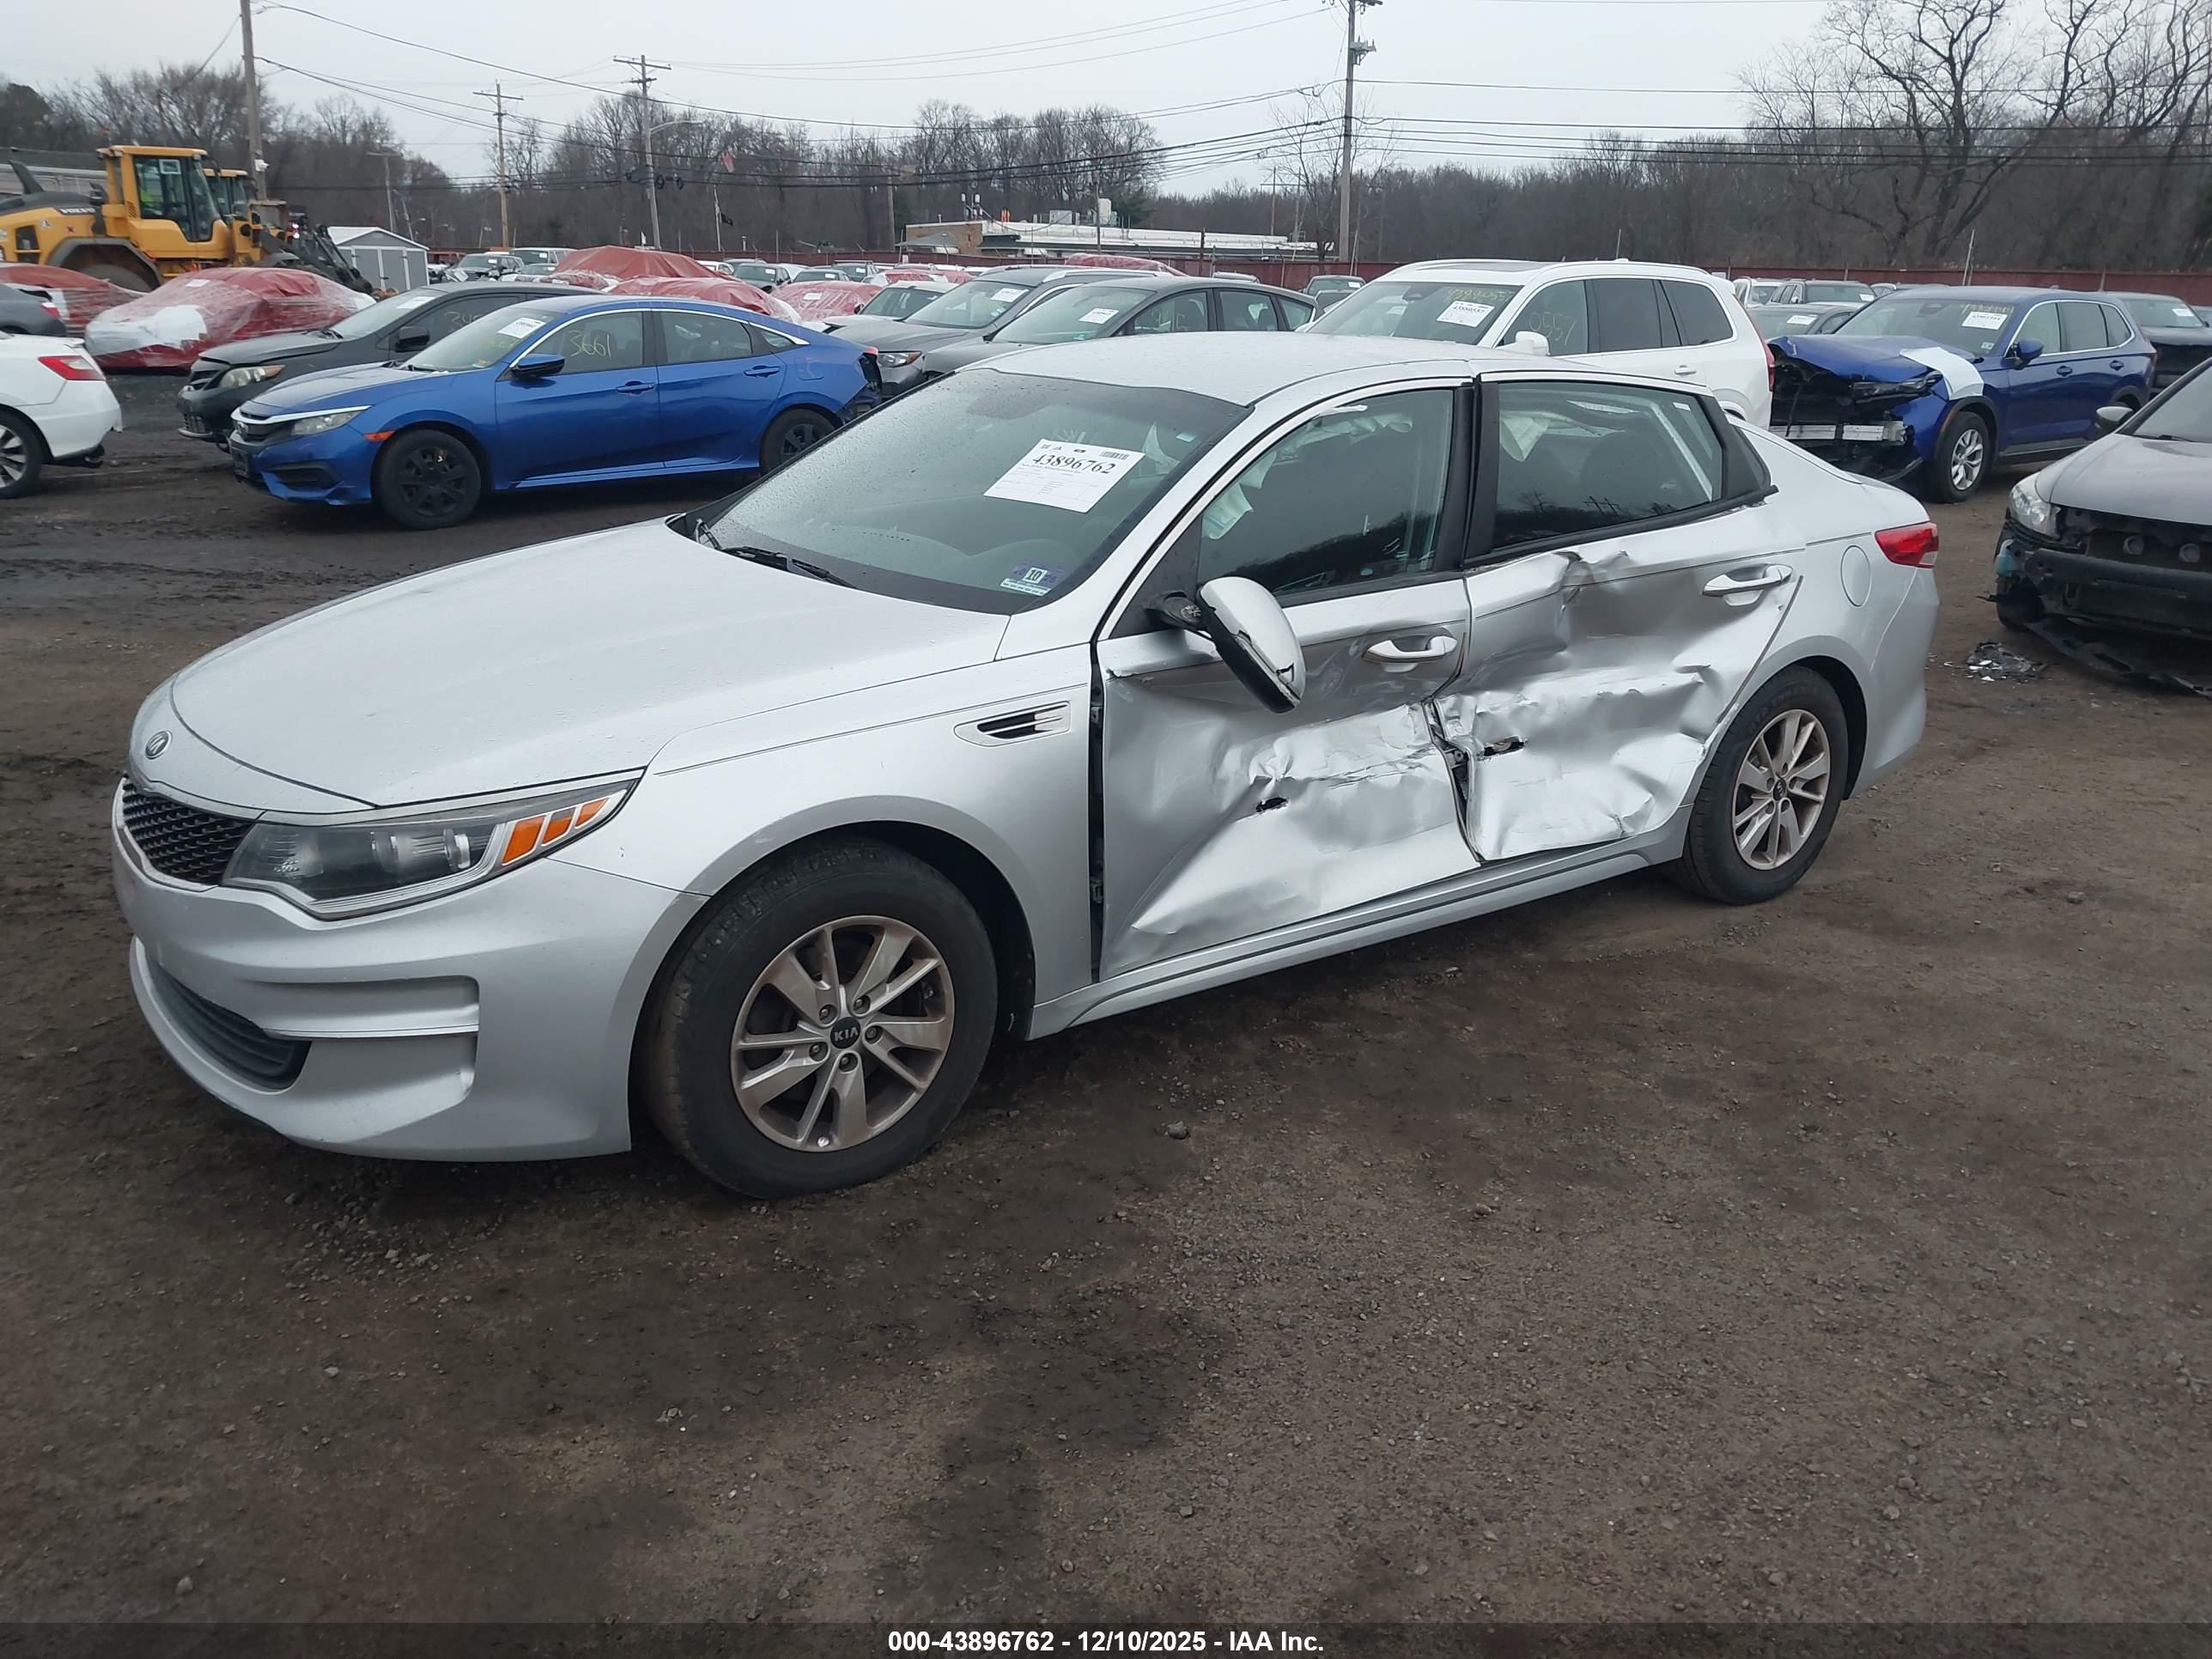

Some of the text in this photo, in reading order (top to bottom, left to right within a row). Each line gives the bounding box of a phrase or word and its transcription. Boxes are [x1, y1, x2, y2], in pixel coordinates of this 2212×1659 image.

[568, 330, 611, 359] 3661
[1032, 453, 1116, 474] 43896762
[1025, 569, 1042, 581] 10
[834, 1026, 859, 1042] KIA
